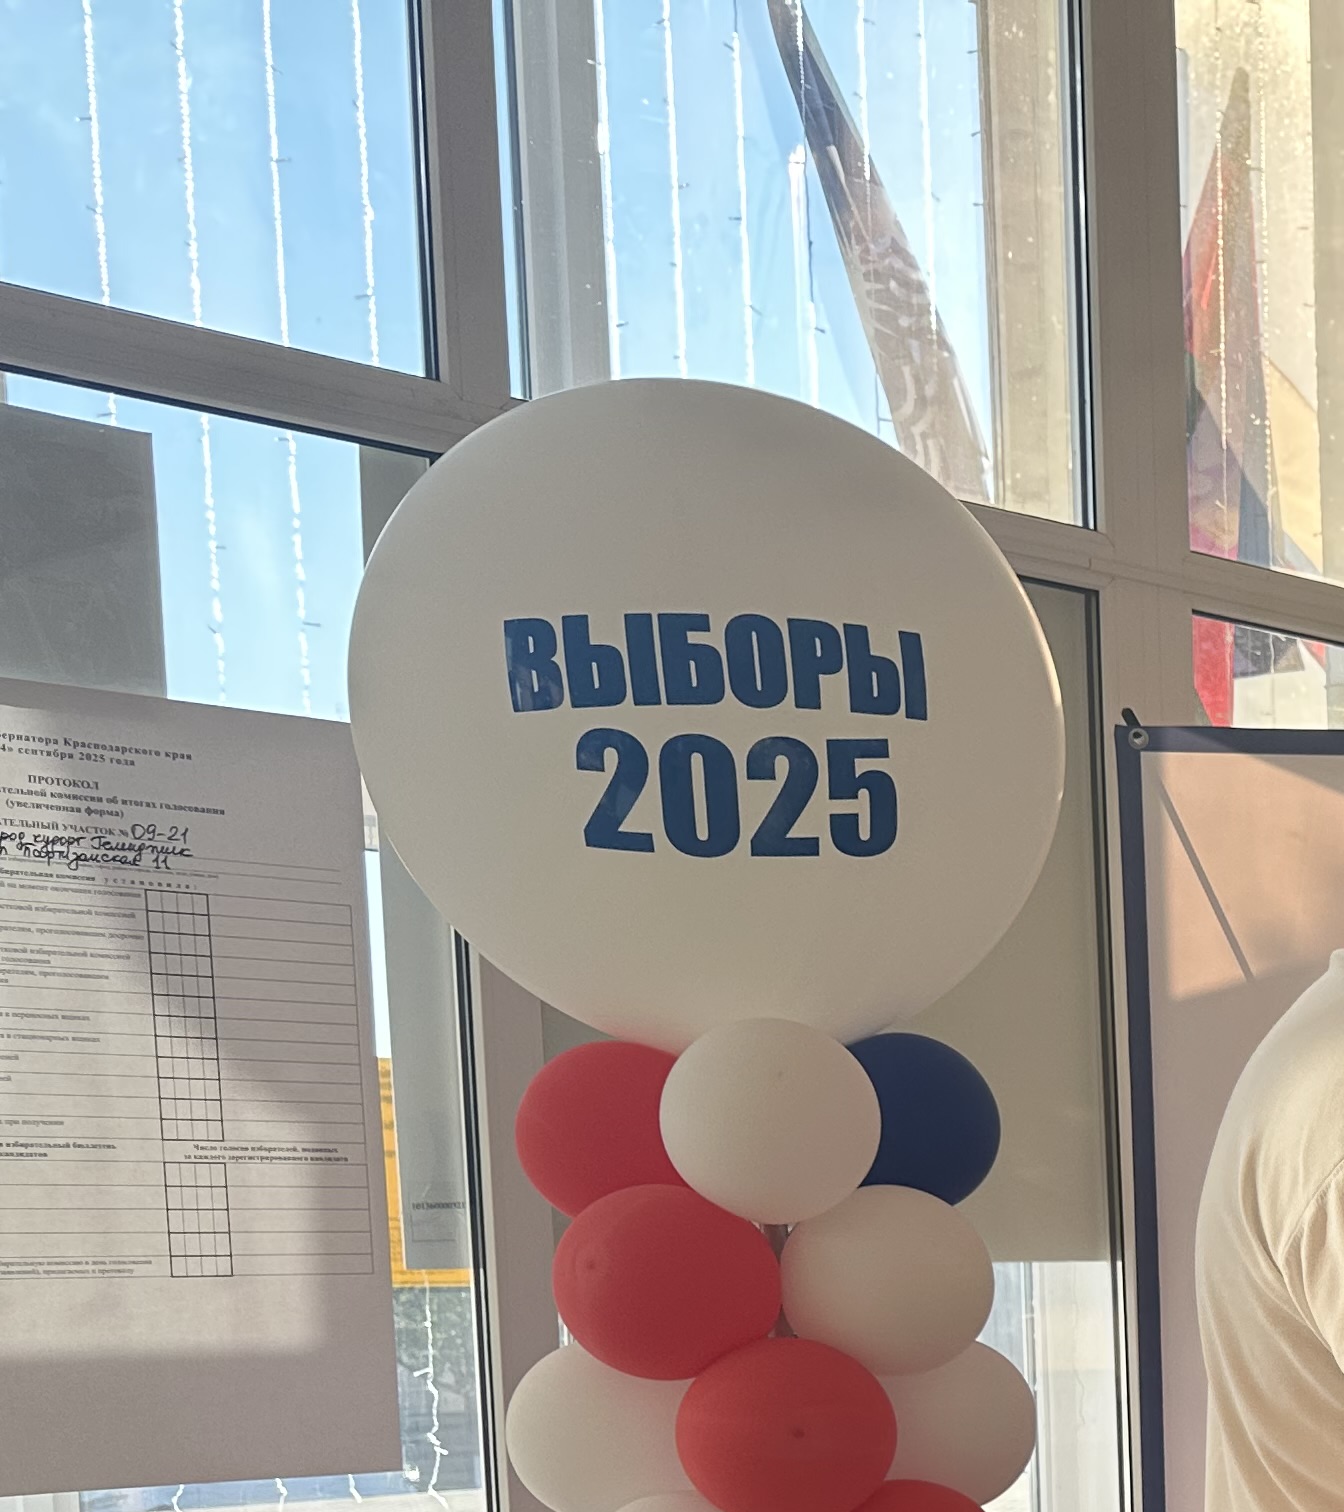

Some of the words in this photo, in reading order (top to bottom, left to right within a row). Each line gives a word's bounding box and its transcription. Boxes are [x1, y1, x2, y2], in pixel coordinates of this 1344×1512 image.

[503, 613, 928, 721] ВЫБОРЫ
[0, 732, 59, 746] ернатора
[63, 737, 161, 757] Краснодарского
[165, 751, 192, 761] края
[18, 747, 74, 760] сентября
[79, 751, 105, 763] 2025
[109, 757, 135, 766] года
[28, 774, 99, 791] ПРОТОКОЛ
[576, 727, 898, 858] 2025
[0, 786, 47, 797] тельной
[50, 792, 104, 803] комиссии
[106, 796, 119, 805] об
[121, 799, 157, 809] итогах
[160, 802, 225, 815] голосования
[84, 806, 124, 819] форма)
[0, 818, 59, 831] ТЕЛЬНЫЙ
[62, 823, 117, 837] УЧАСТОК
[131, 823, 188, 844] 09-21
